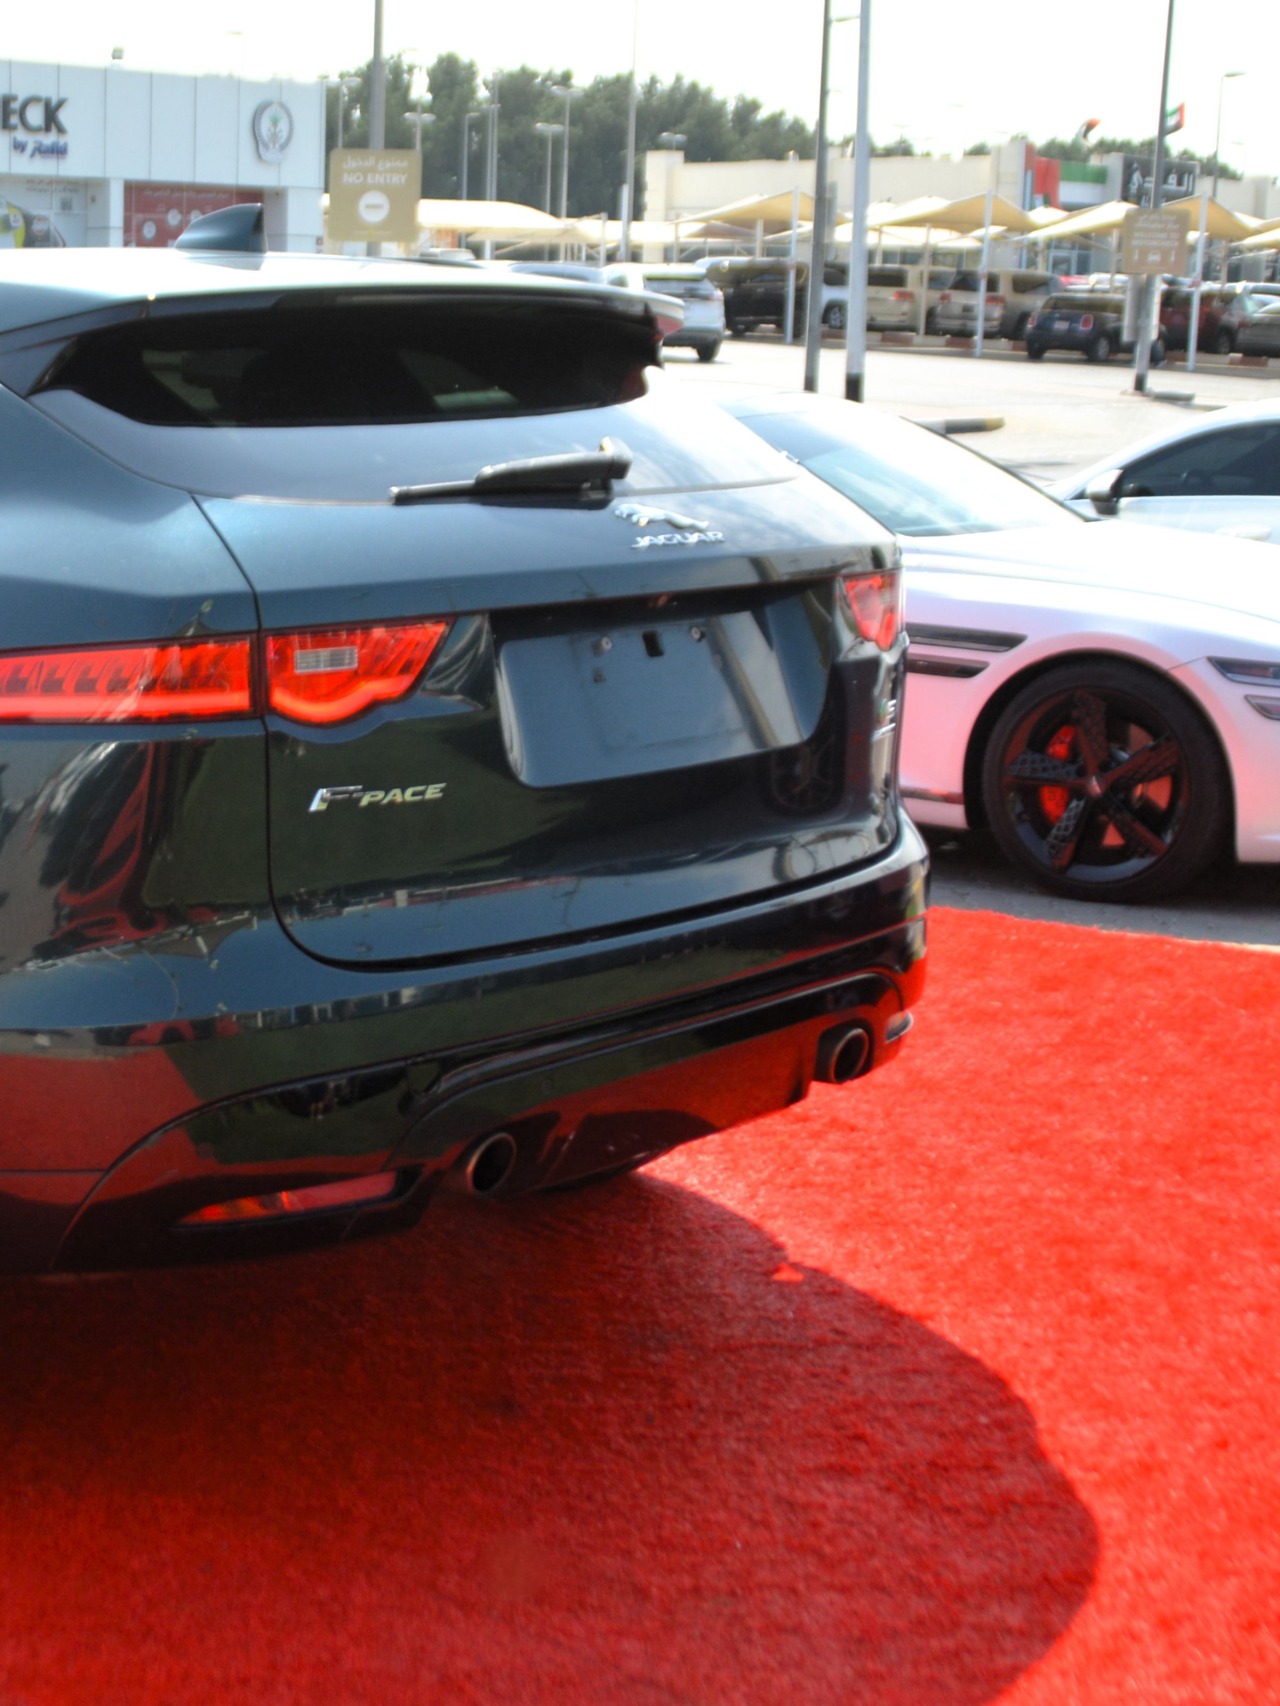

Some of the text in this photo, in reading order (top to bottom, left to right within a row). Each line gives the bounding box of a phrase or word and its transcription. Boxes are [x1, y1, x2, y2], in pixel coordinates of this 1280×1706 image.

[13, 136, 28, 153] by
[344, 172, 407, 184] NO ENTRY
[630, 531, 725, 548] JAGUAR
